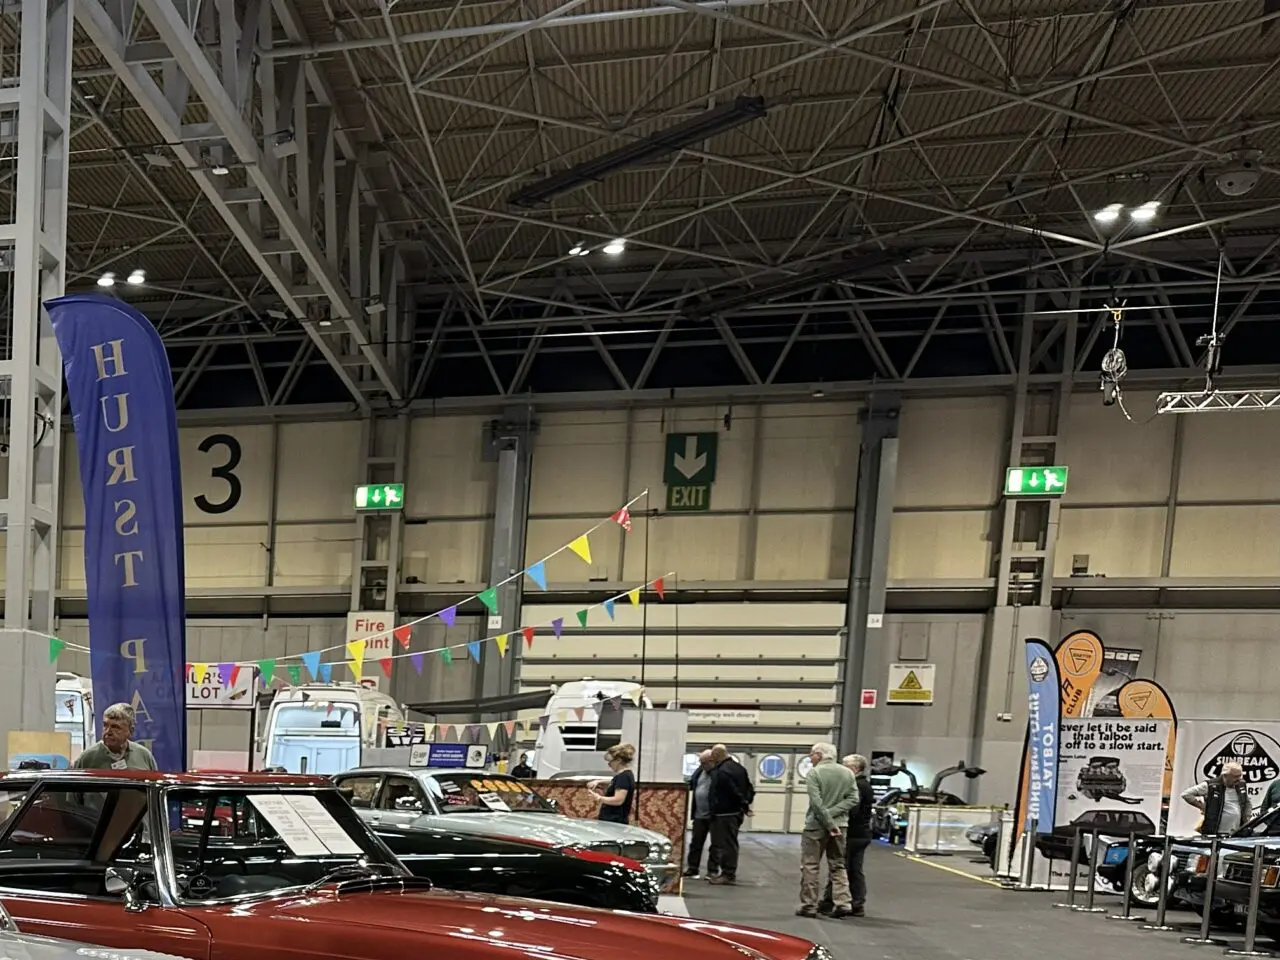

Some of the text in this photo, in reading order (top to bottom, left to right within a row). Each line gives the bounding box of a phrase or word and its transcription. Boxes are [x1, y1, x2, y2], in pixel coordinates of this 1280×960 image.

[193, 434, 242, 514] 3
[671, 485, 707, 507] EXIT
[355, 619, 385, 632] Fire
[351, 637, 389, 649] oint
[191, 687, 221, 699] LOT
[1066, 688, 1083, 715] CLUB
[1060, 723, 1157, 733] ever let it be said
[1073, 732, 1133, 741] that Talbot
[1065, 740, 1081, 749] off
[1084, 741, 1096, 750] to
[1109, 740, 1134, 750] slow
[1137, 742, 1165, 751] start.
[1216, 756, 1268, 766] SUNBEAM
